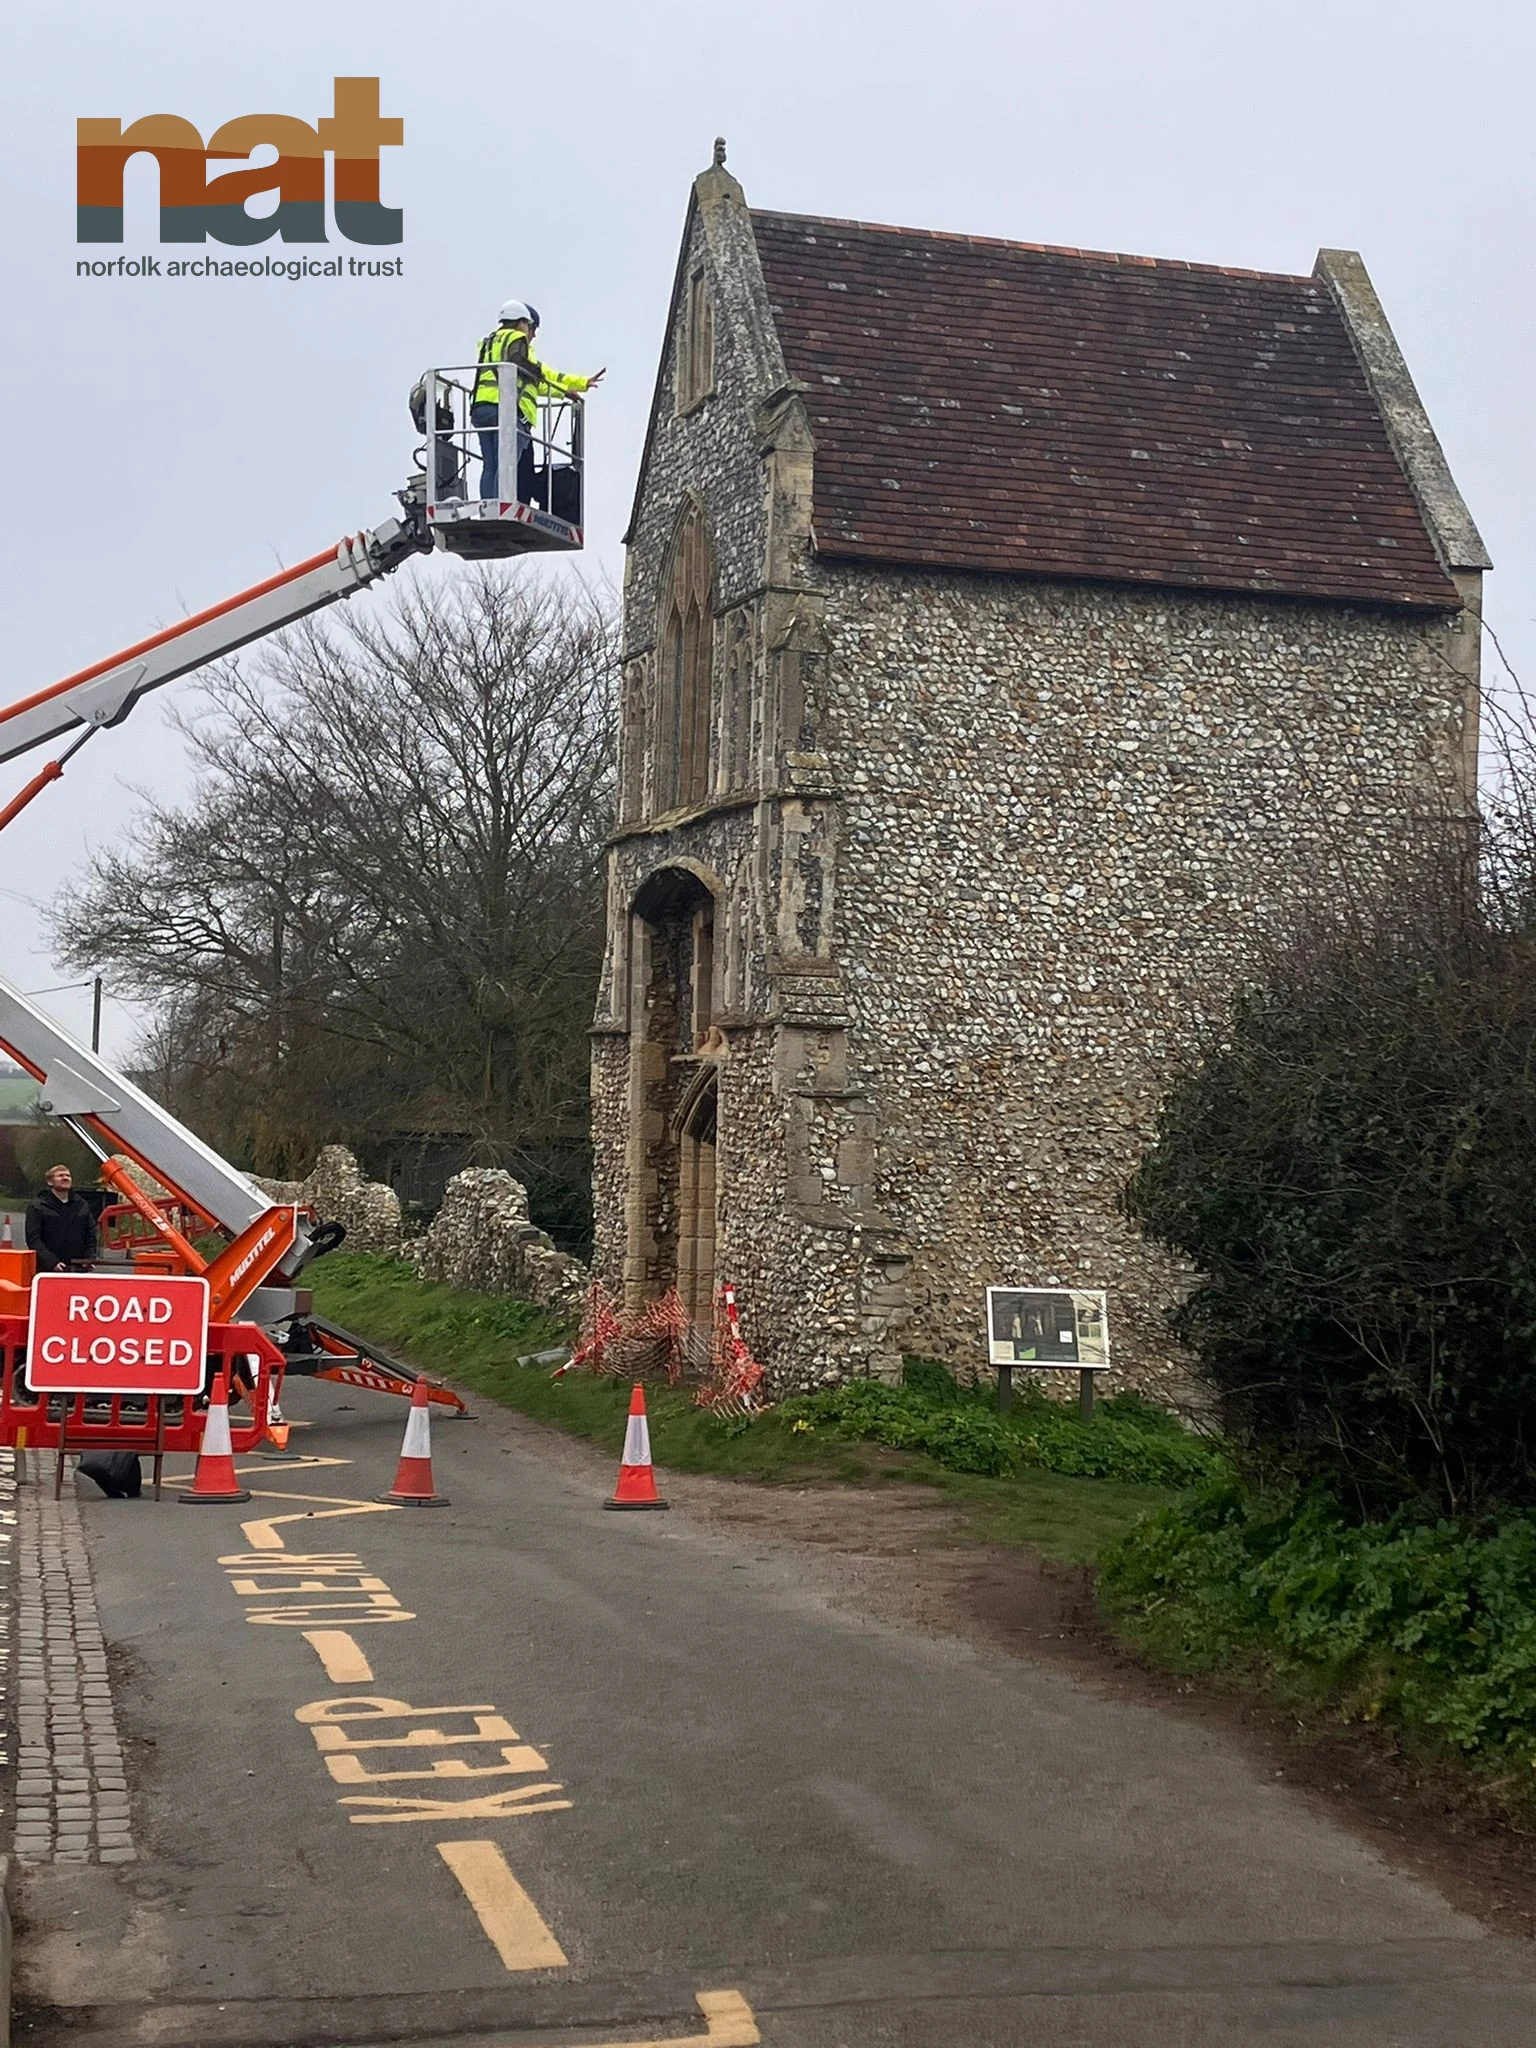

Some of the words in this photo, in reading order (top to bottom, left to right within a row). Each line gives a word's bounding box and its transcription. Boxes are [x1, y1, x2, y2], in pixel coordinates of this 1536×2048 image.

[229, 1227, 276, 1288] MULTITEL
[68, 1295, 173, 1323] ROAD
[41, 1336, 193, 1366] CLOSED
[217, 1553, 417, 1625] CLEAR
[295, 1696, 574, 1824] KEEP
